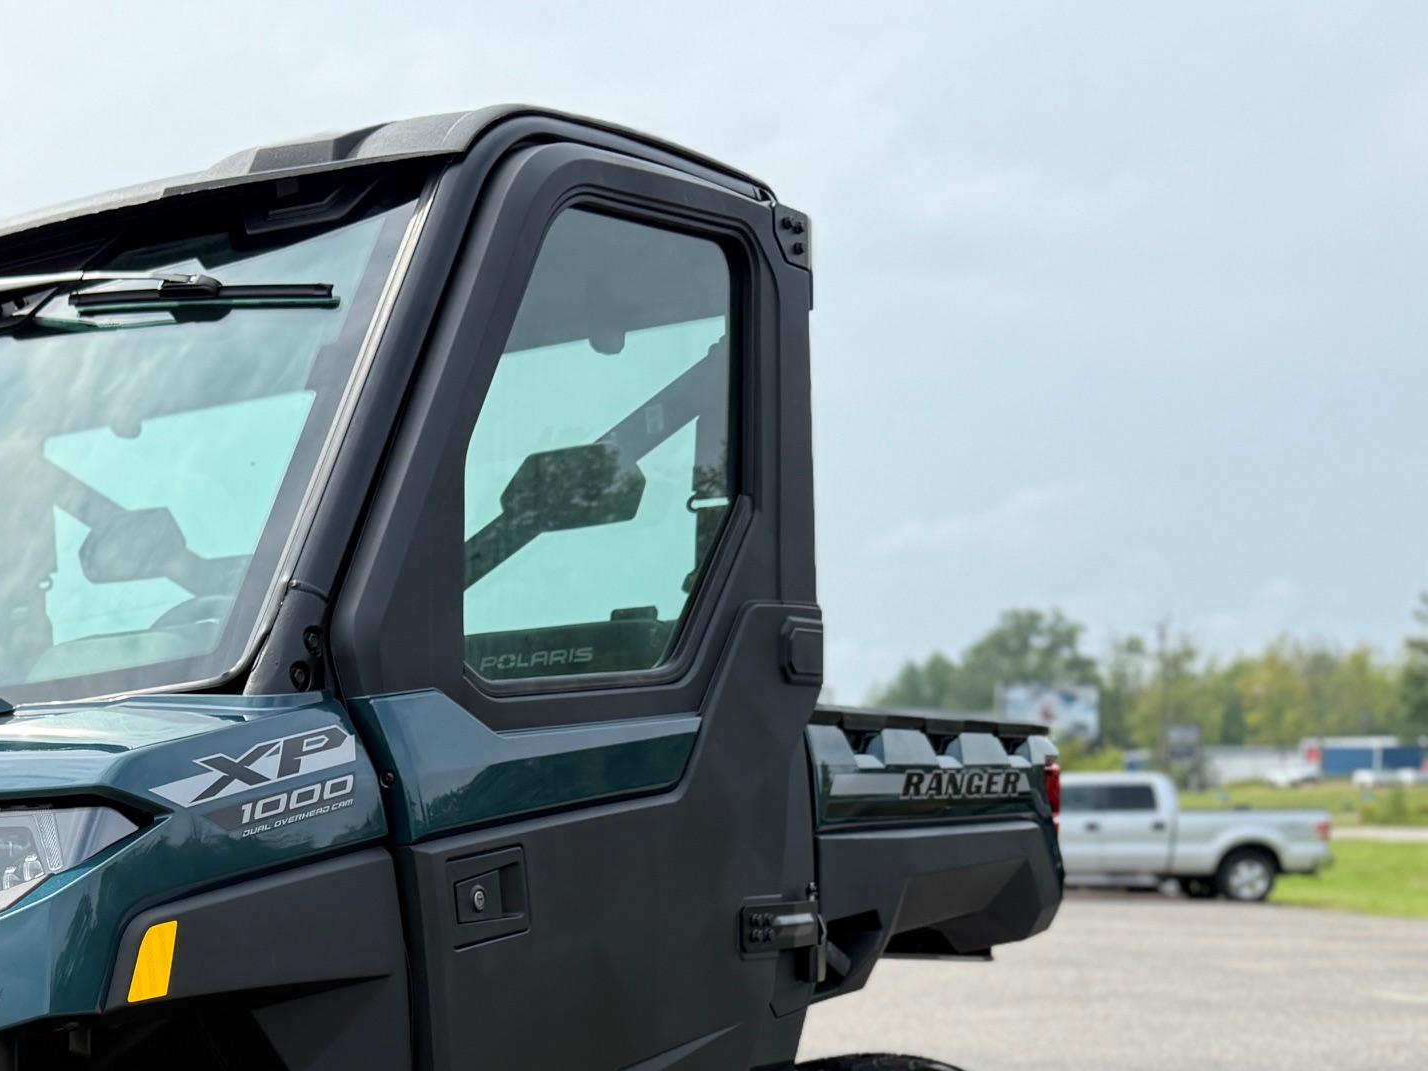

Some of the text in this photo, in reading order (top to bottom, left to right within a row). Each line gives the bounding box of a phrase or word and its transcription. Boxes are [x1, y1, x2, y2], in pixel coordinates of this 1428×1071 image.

[479, 646, 594, 671] POLARIS
[189, 725, 349, 804] XP
[899, 769, 1022, 800] RANGER
[241, 773, 355, 825] 1000
[242, 798, 354, 838] DUAL OVERHEAD CAM
